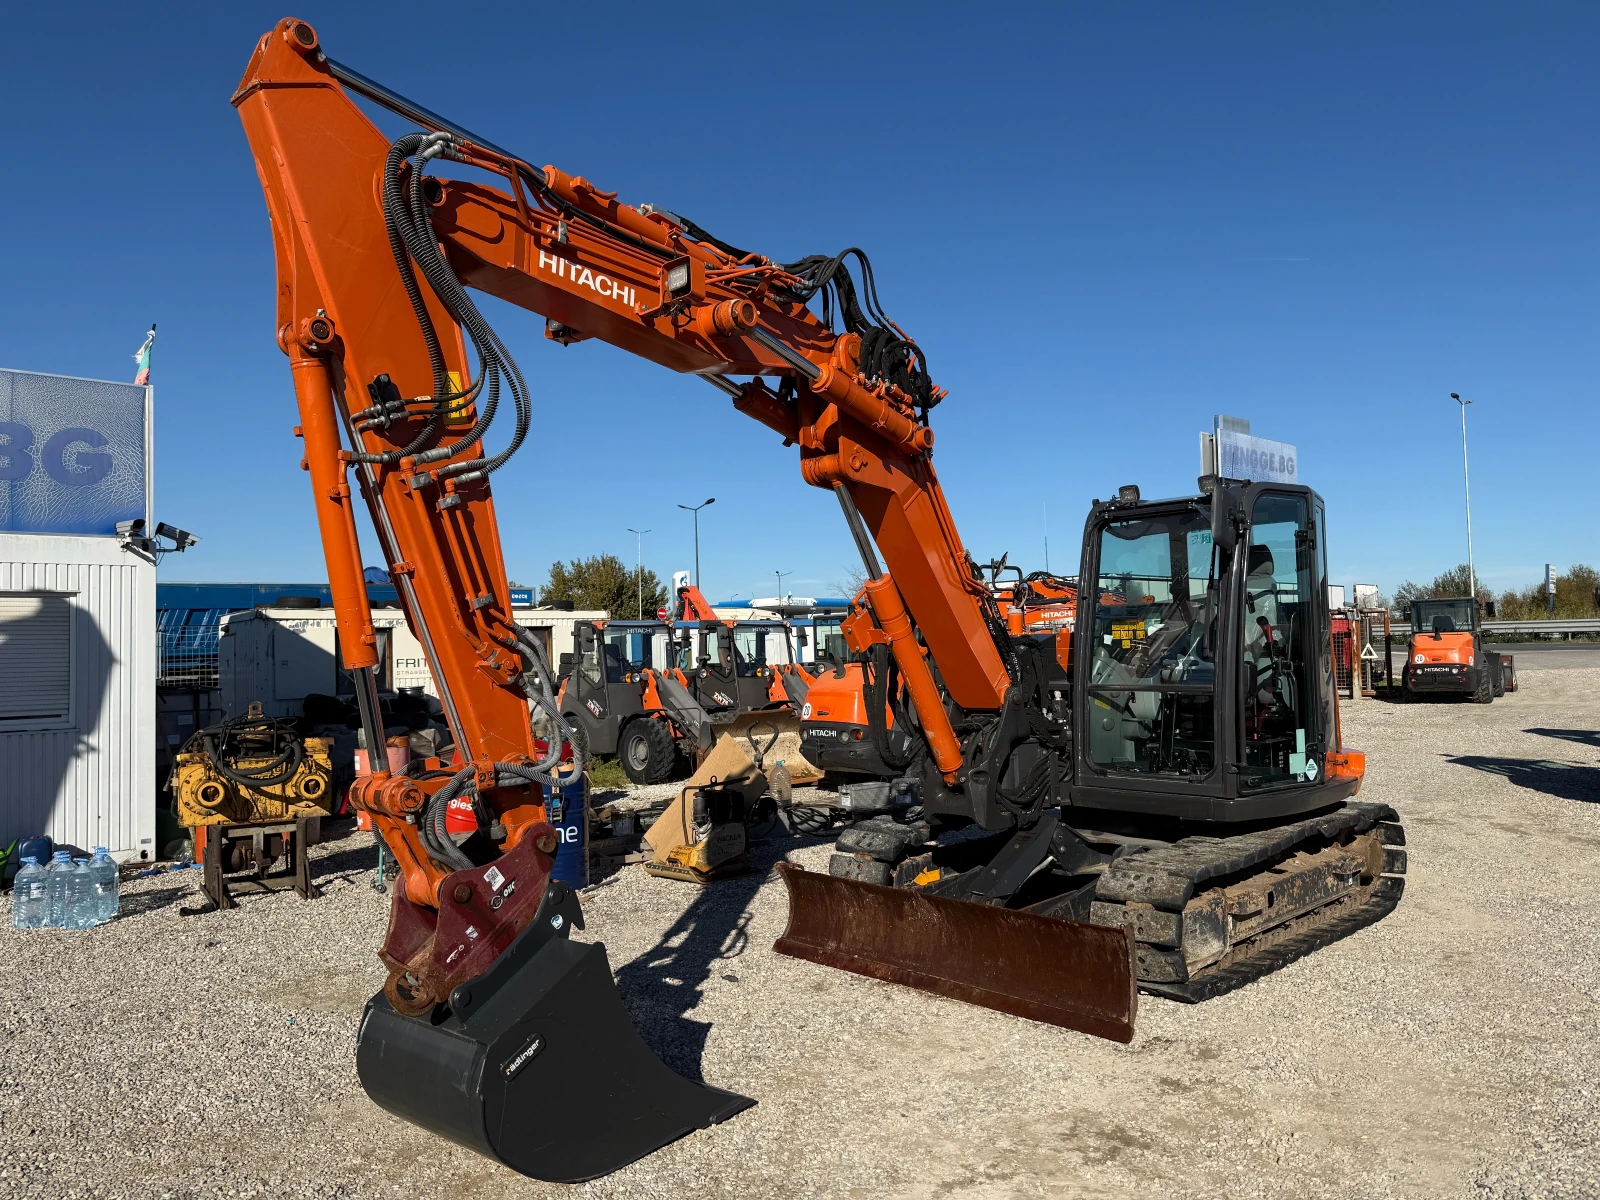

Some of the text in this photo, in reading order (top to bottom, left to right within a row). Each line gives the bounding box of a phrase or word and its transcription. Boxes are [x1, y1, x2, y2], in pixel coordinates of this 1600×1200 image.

[538, 249, 635, 307] HITACHI
[1041, 610, 1073, 619] HITACHI
[1416, 655, 1424, 663] 20
[803, 705, 811, 716] 20
[809, 729, 837, 738] HITACHI
[448, 798, 473, 811] gies
[717, 833, 742, 843] WACKER
